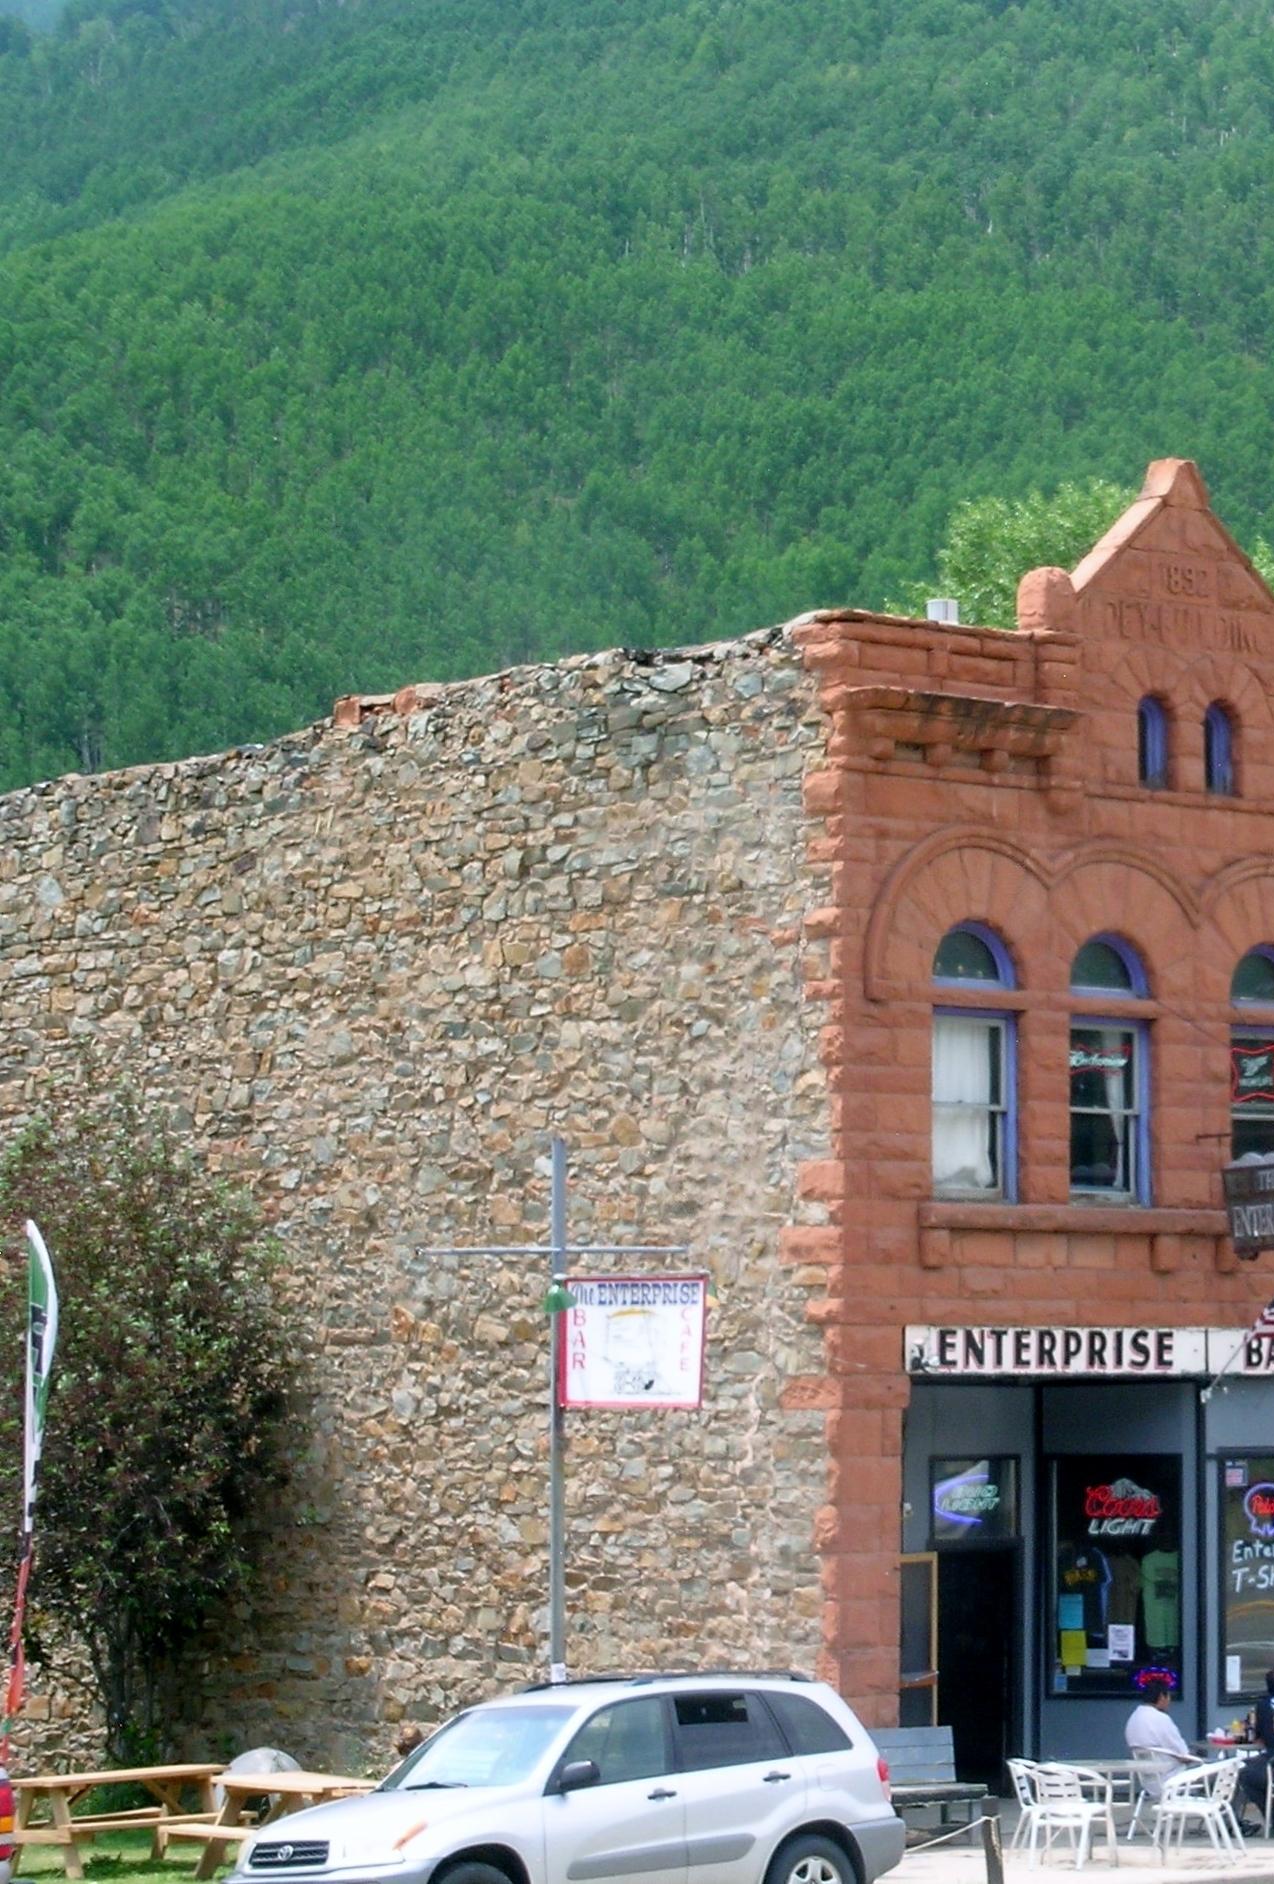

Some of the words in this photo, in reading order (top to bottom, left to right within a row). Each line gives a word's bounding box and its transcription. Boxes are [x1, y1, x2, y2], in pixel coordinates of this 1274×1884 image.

[597, 1283, 700, 1306] ENTERPRISE
[573, 1309, 586, 1370] BAR
[937, 1328, 1175, 1370] ENTERPRISE
[1088, 1517, 1157, 1536] LIGHT
